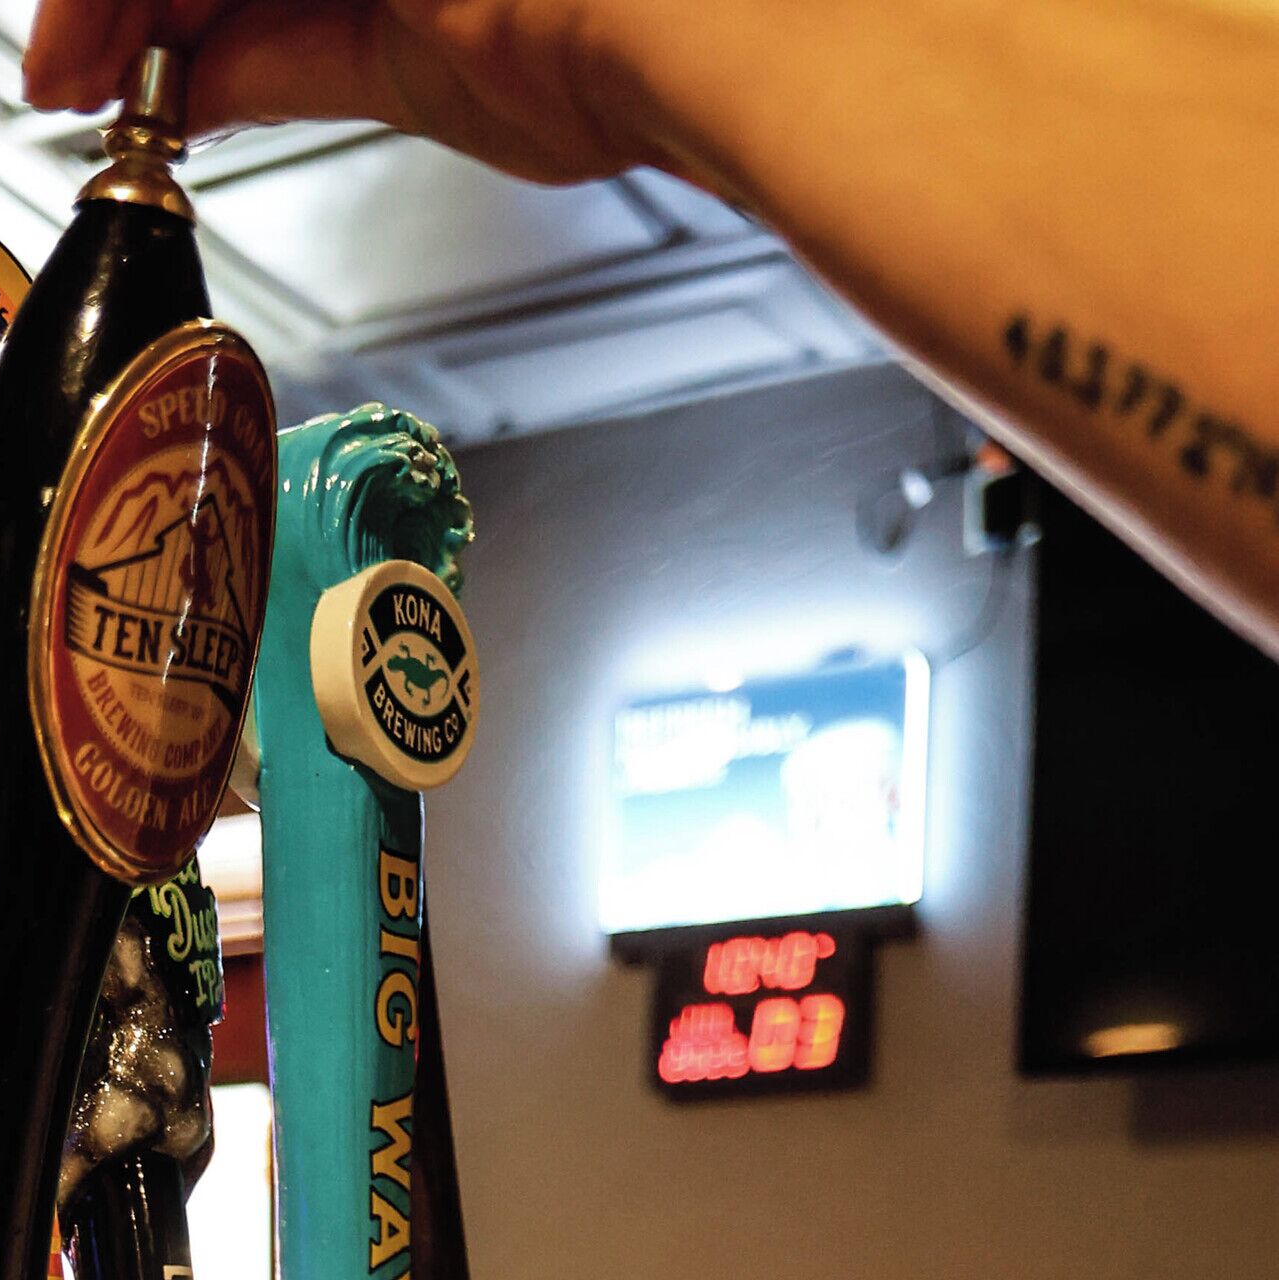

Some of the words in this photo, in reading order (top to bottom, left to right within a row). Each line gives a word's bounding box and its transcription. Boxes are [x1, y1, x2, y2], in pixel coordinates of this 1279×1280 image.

[92, 605, 164, 664] TEN
[170, 618, 241, 680] SLEEP
[393, 593, 441, 642] KONA
[87, 671, 160, 760] BREWING
[373, 682, 442, 754] BREWING
[75, 742, 170, 831] GOLDEN
[374, 851, 420, 1051] BIG
